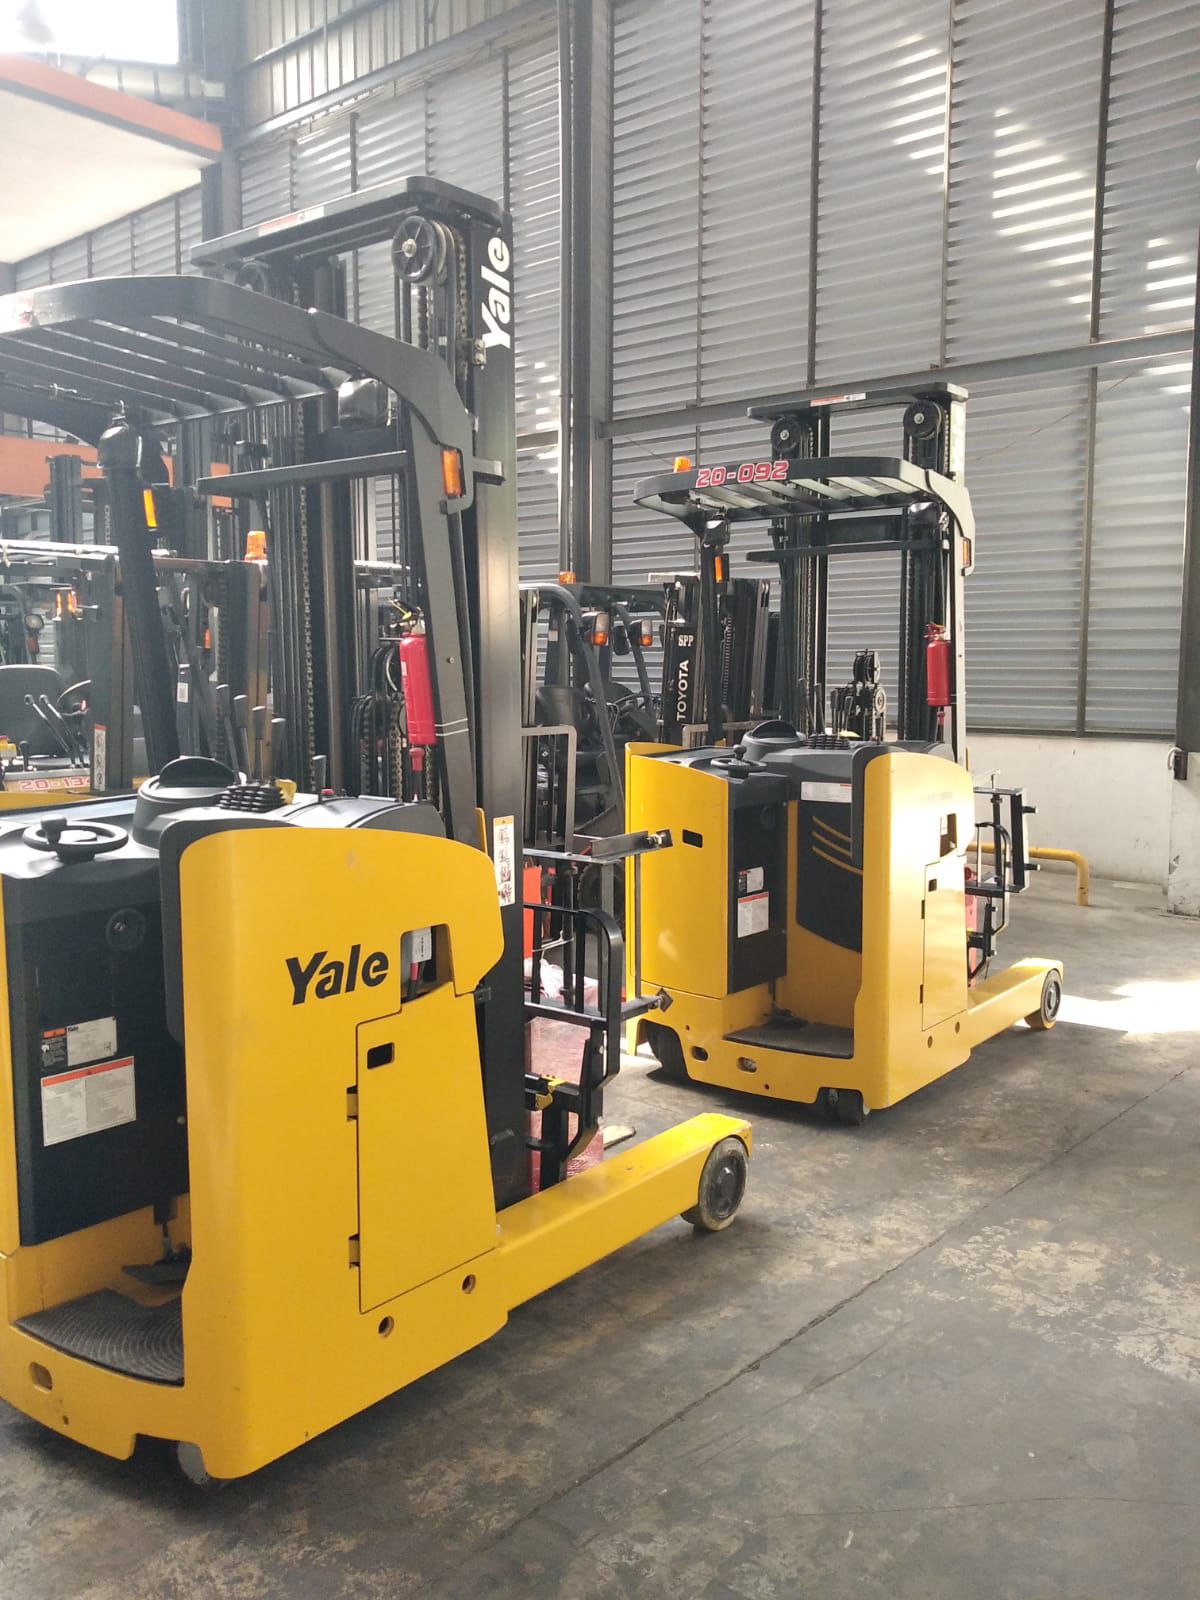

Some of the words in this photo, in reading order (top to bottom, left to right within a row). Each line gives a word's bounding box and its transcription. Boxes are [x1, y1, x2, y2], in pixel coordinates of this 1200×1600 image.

[481, 237, 511, 349] Yale
[696, 460, 789, 488] 20-092
[678, 635, 694, 647] SPP
[677, 660, 689, 721] TOYOTA
[285, 943, 389, 1006] Yale
